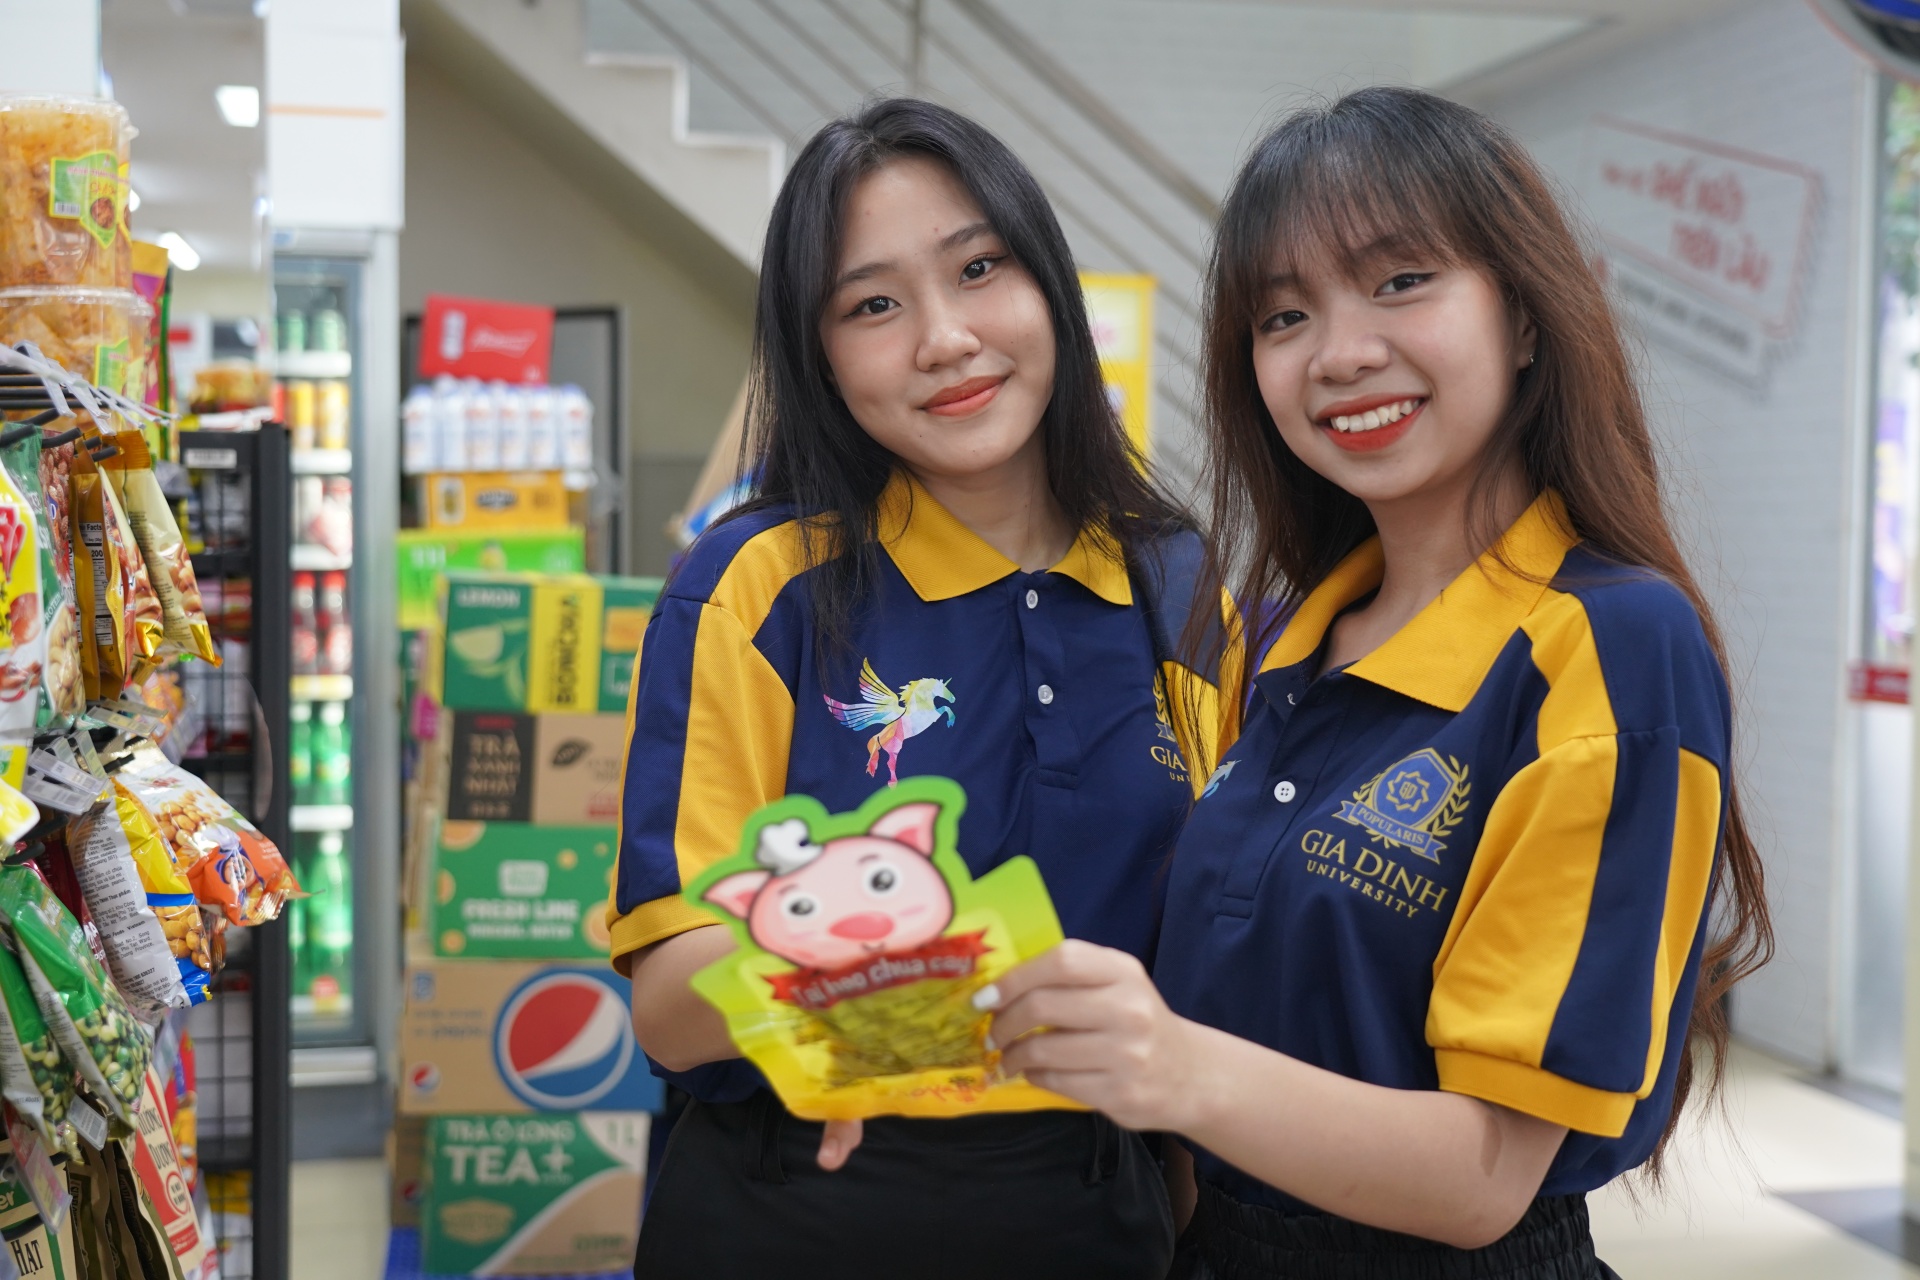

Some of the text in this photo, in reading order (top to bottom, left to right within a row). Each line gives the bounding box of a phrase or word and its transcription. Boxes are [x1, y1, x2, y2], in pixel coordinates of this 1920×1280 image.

[457, 589, 521, 608] LEMON
[1150, 746, 1187, 771] GIA
[1357, 807, 1424, 845] POPULARIS
[1301, 830, 1448, 912] GIA DINH
[1306, 859, 1418, 918] UNIVERSITY
[868, 956, 926, 983] chua
[928, 955, 972, 974] cay
[446, 1116, 488, 1141] TRÀ
[515, 1120, 577, 1144] LONG
[443, 1145, 575, 1184] TEA+
[11, 1238, 44, 1276] HẠT
